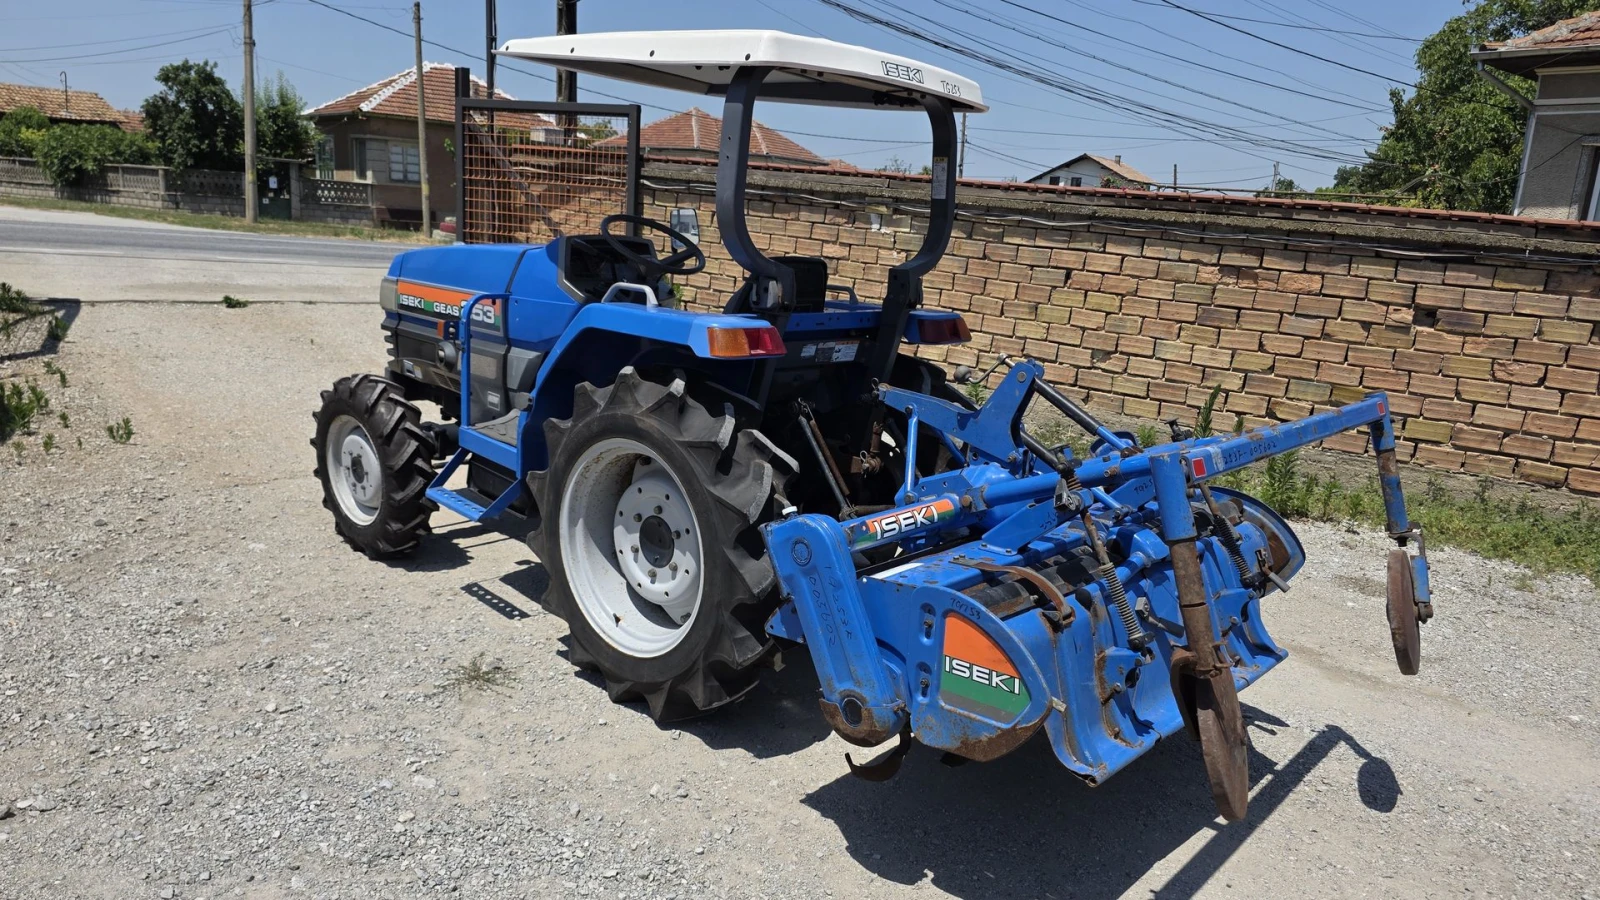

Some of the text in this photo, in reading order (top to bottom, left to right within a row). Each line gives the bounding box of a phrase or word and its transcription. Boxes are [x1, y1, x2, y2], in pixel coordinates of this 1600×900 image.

[881, 61, 924, 84] ISEKI
[399, 293, 425, 309] ISEKI
[433, 302, 460, 317] GEAS
[874, 505, 939, 541] ISEKI
[944, 655, 1021, 695] ISEKI
